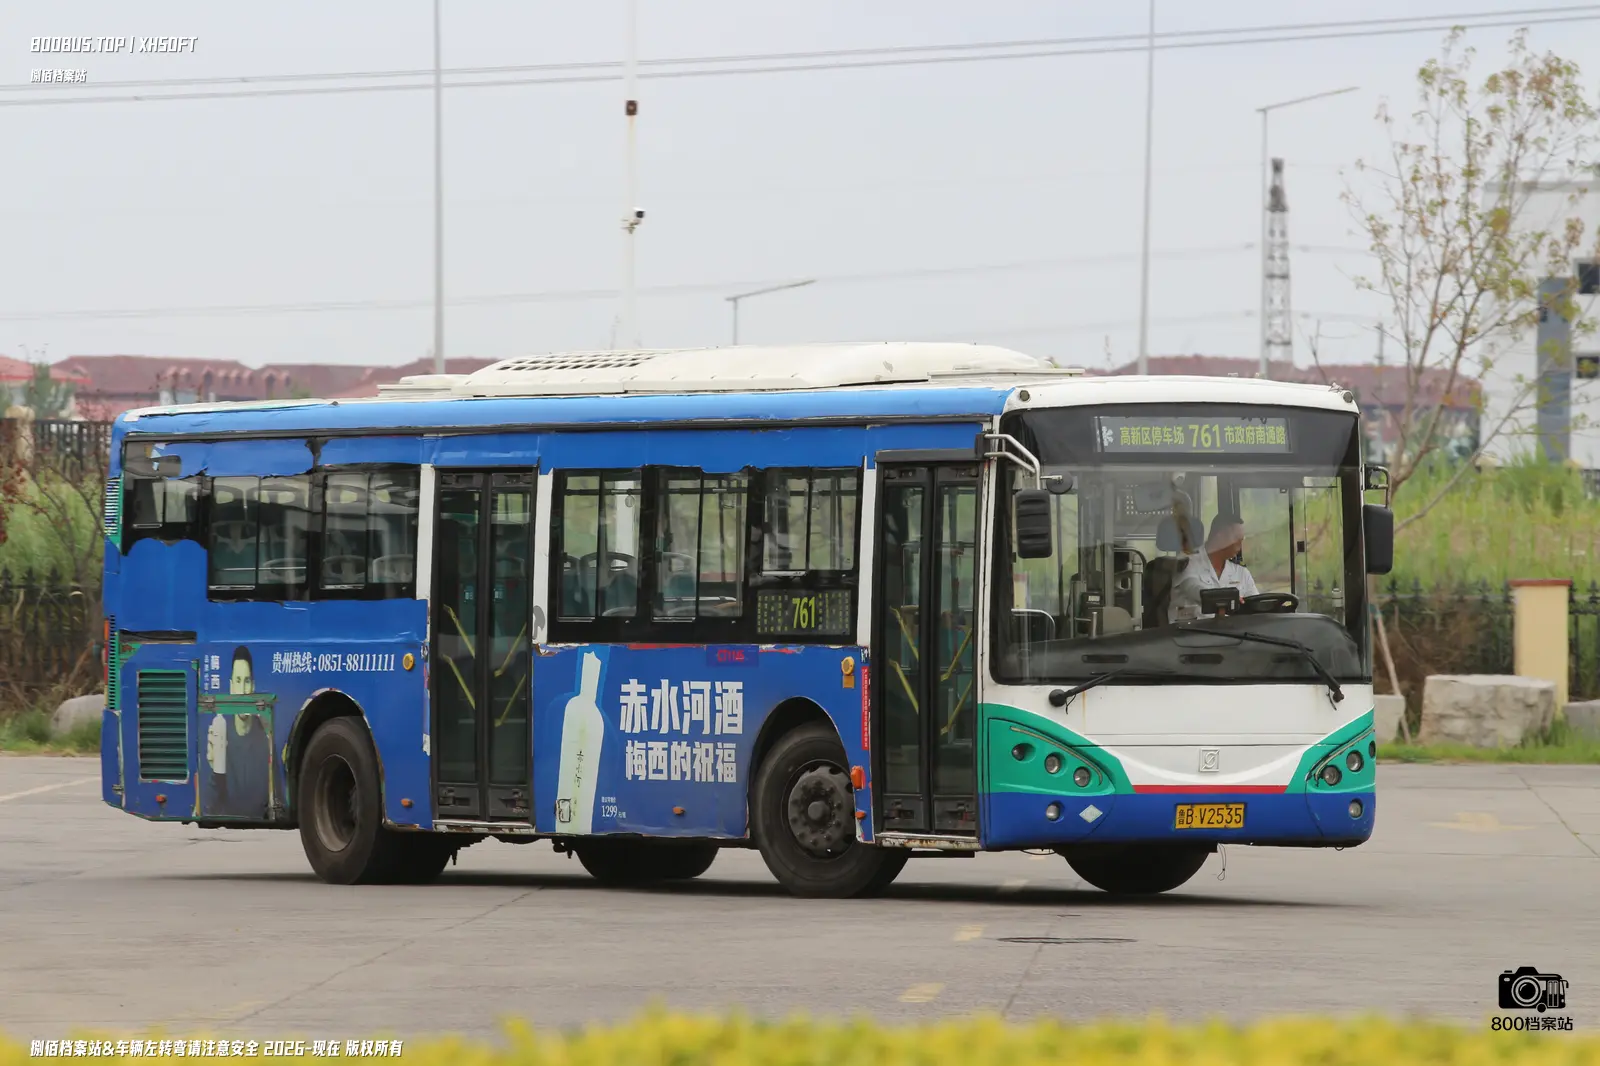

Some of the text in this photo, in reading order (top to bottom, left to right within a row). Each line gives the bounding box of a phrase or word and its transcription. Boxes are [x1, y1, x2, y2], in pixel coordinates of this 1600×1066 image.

[1119, 424, 1287, 448] 高新区停车场 761 市政府南通路
[791, 596, 816, 629] 761
[619, 678, 744, 735] 赤水河酒
[625, 740, 737, 783] 梅西的祝福
[601, 805, 618, 818] 1299
